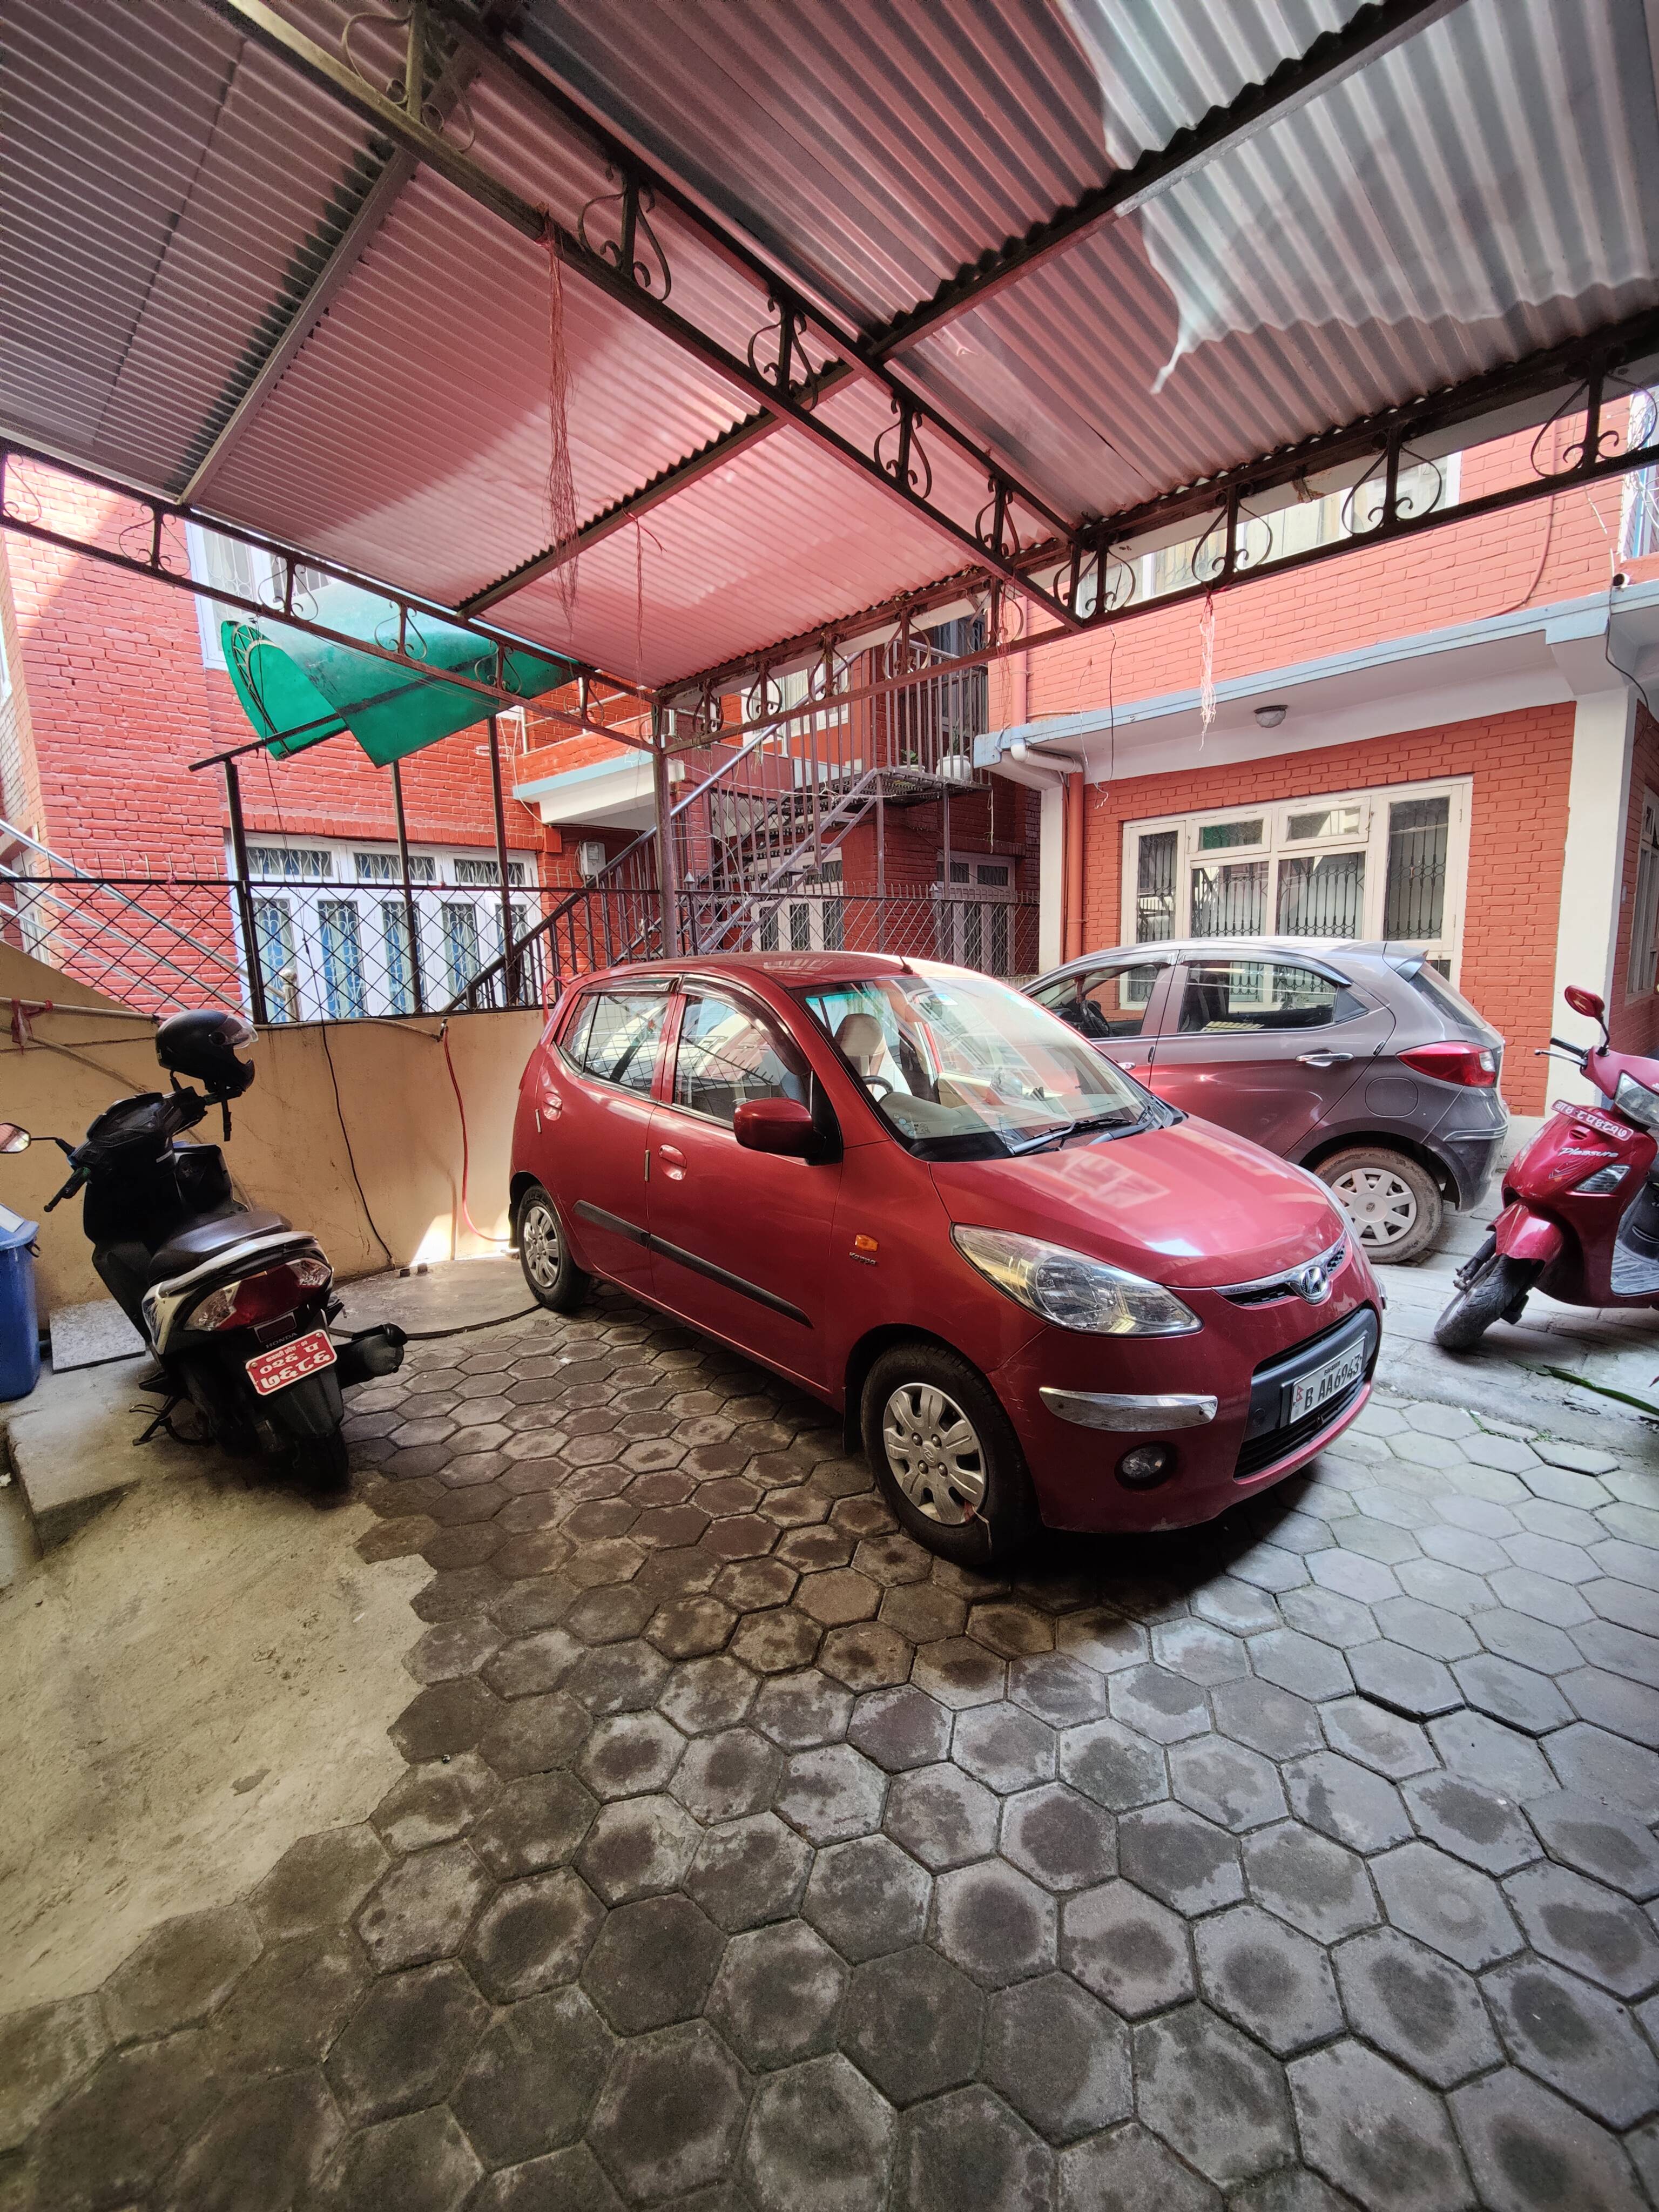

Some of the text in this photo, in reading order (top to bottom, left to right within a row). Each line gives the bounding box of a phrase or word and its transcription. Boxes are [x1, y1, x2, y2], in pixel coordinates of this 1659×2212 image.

[1557, 1148, 1618, 1158] Pleasure
[266, 1332, 298, 1348] HONDA
[303, 1342, 319, 1353] प
[260, 1350, 331, 1389] ७६८६
[1304, 1386, 1313, 1411] B
